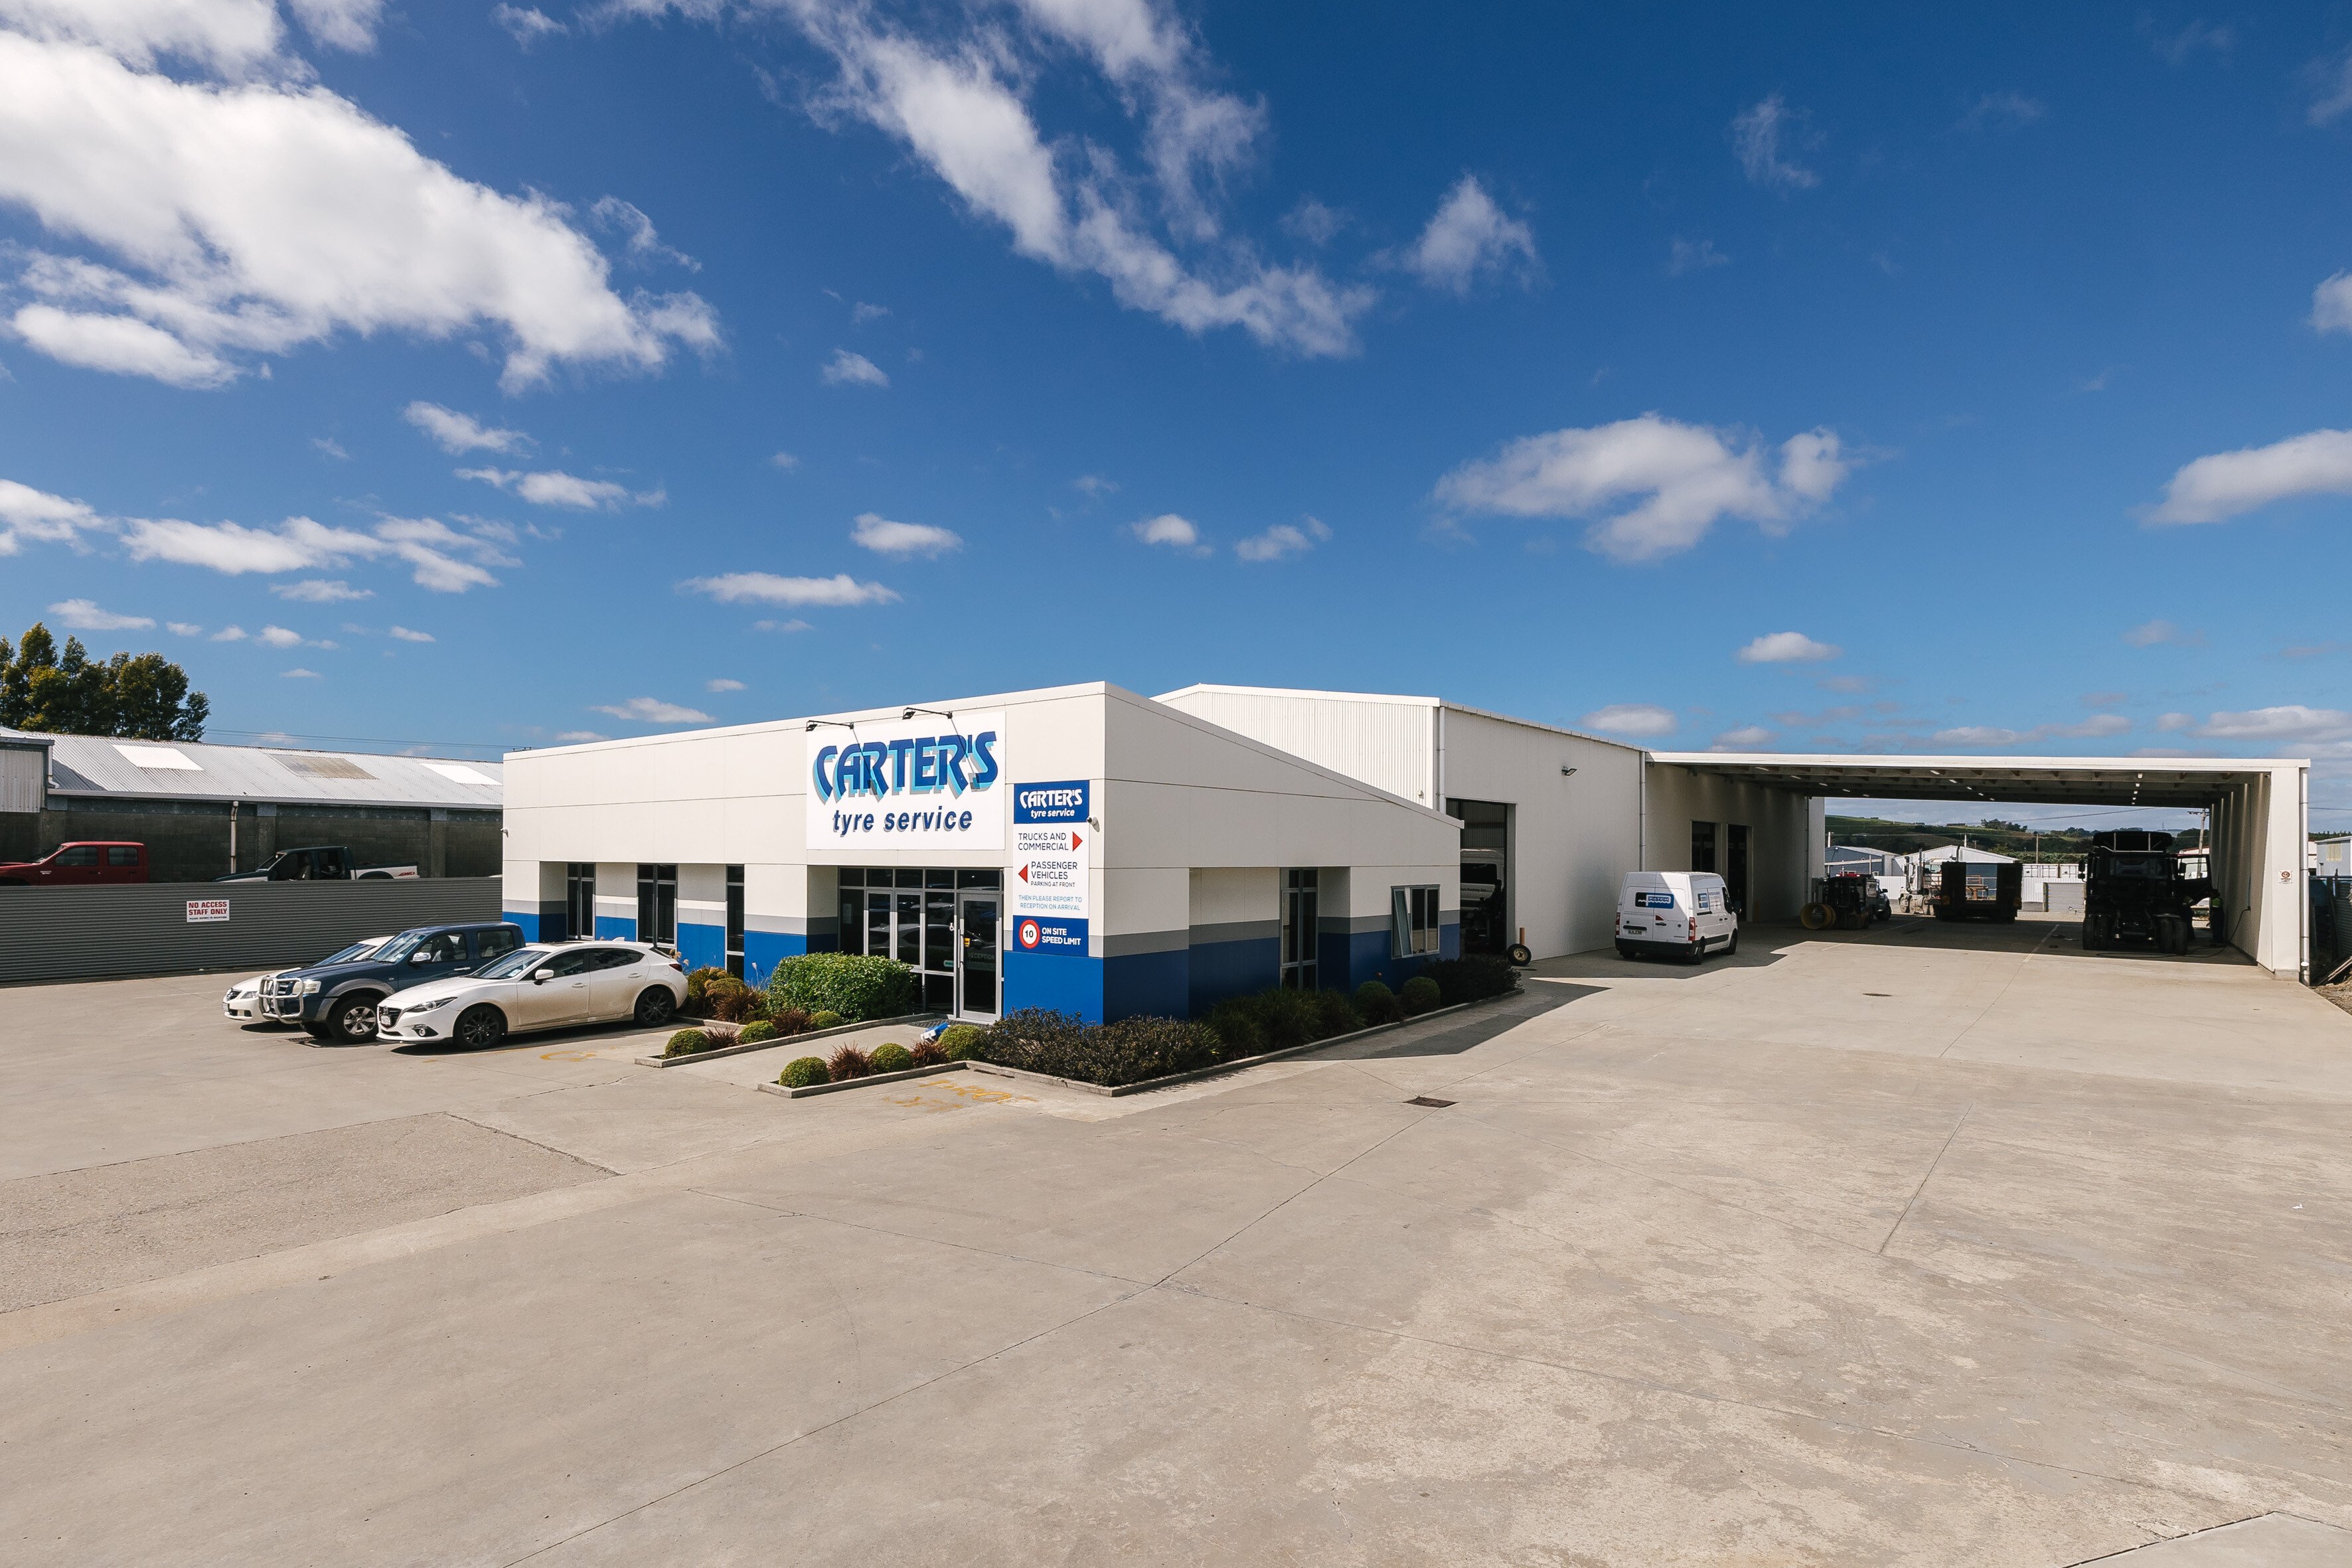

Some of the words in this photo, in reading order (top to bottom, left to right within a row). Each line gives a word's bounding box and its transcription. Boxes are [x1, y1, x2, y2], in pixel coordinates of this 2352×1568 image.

[813, 731, 998, 805] CARTER'S
[1020, 789, 1083, 809] CARTER'S
[1030, 809, 1046, 819] tyre
[1048, 808, 1075, 817] service
[832, 809, 874, 837] tyre
[884, 805, 973, 832] service
[1018, 832, 1048, 841] TRUCKS
[1018, 842, 1069, 851] COMMERCIAL
[1031, 861, 1078, 870] PASSENGER
[1031, 871, 1068, 880] VEHICLES
[1042, 927, 1052, 935] ON
[1042, 936, 1063, 945] SPEED
